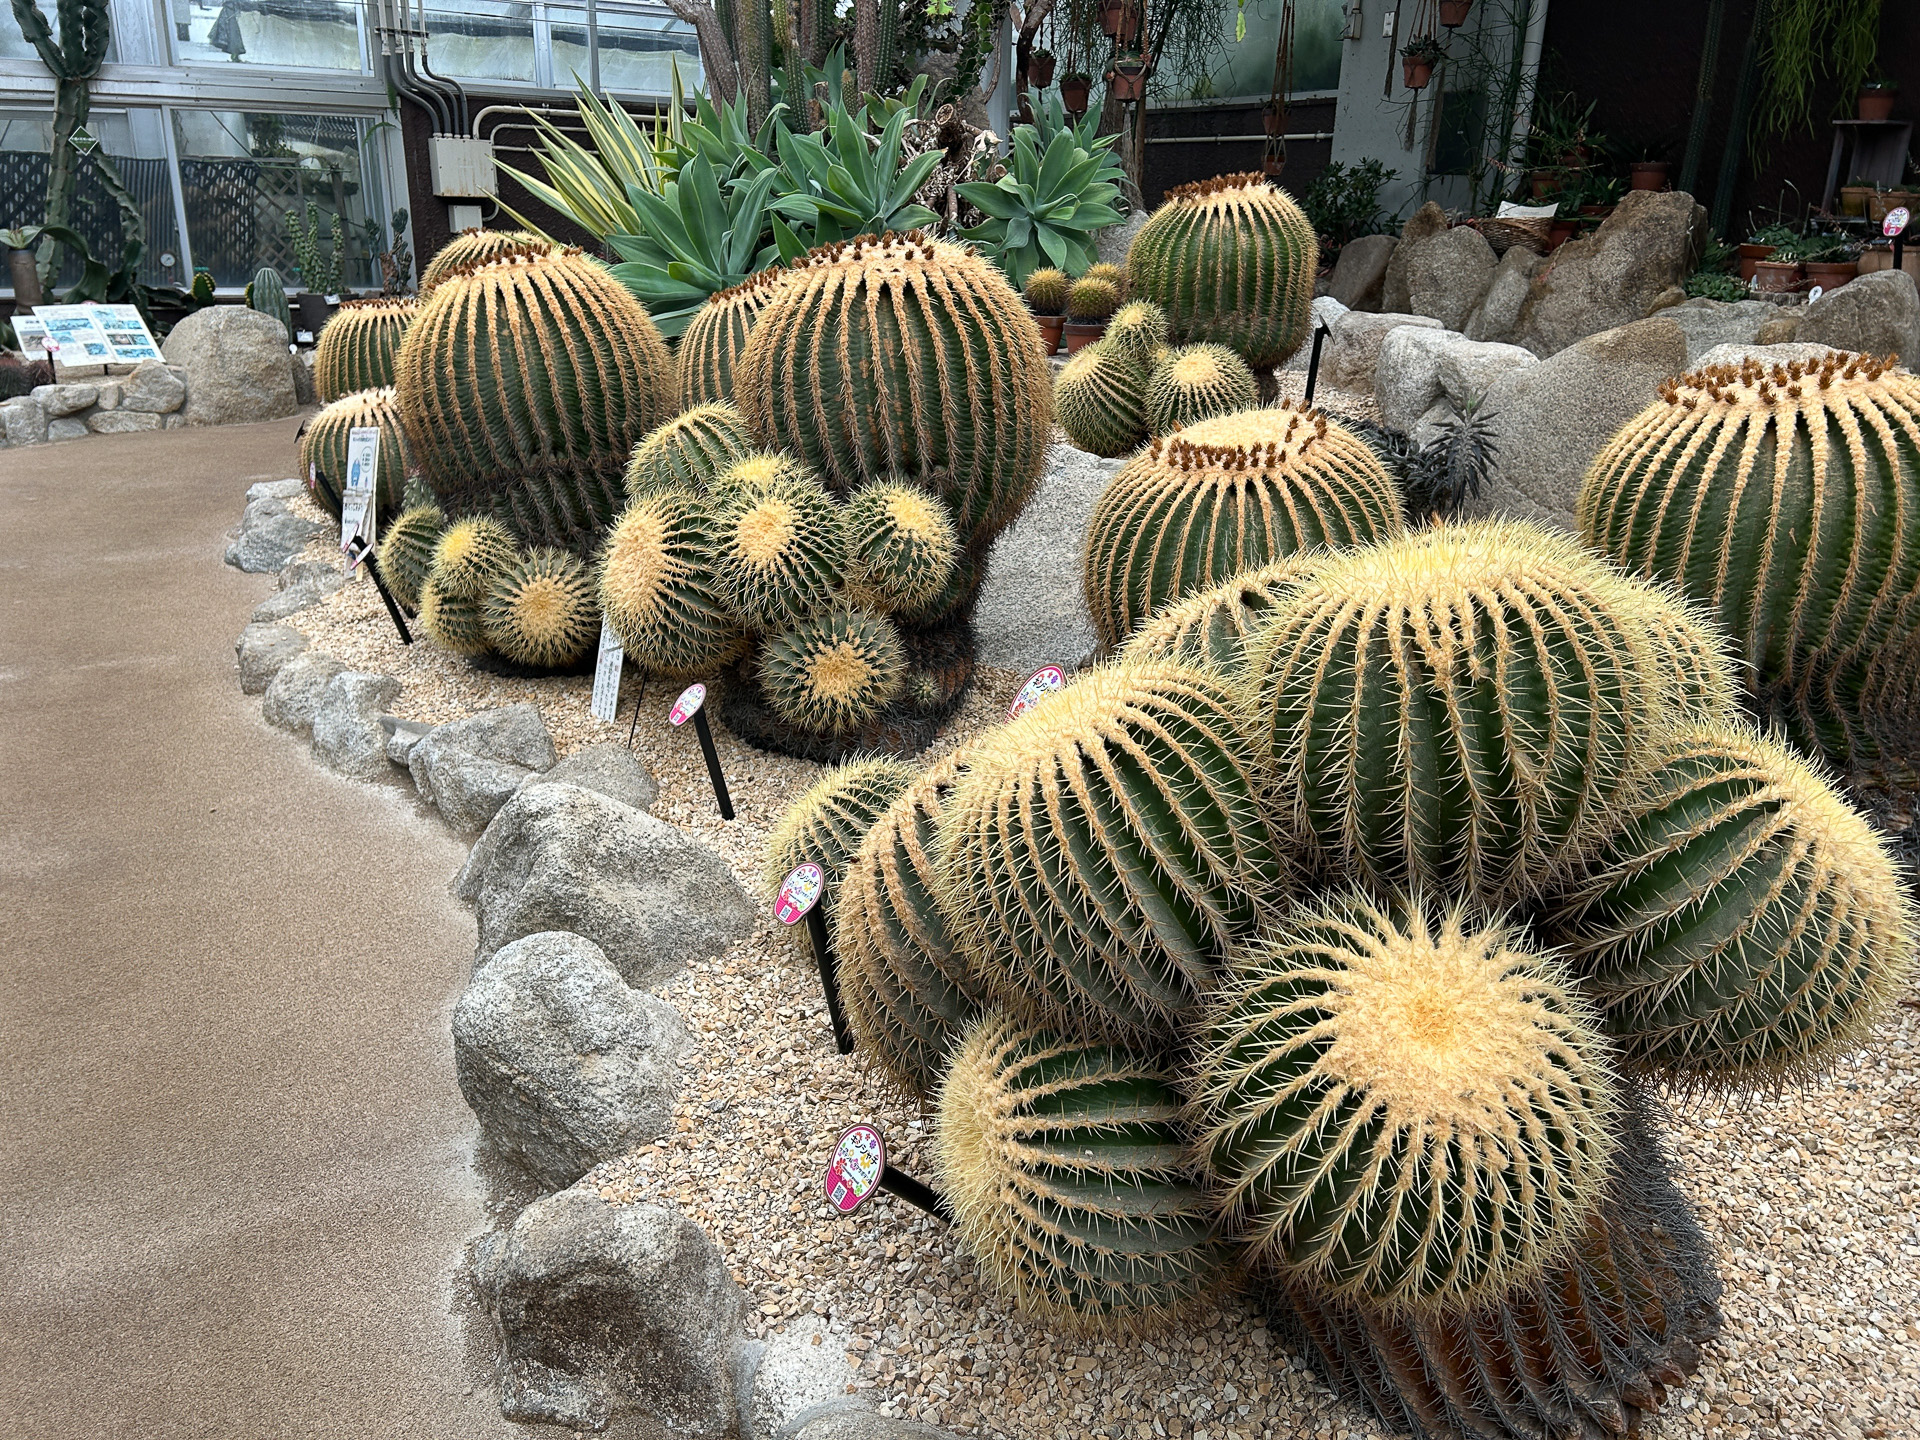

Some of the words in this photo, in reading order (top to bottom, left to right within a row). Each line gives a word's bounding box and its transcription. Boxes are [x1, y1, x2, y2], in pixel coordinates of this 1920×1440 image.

[850, 1135, 879, 1165] キンシャチ
